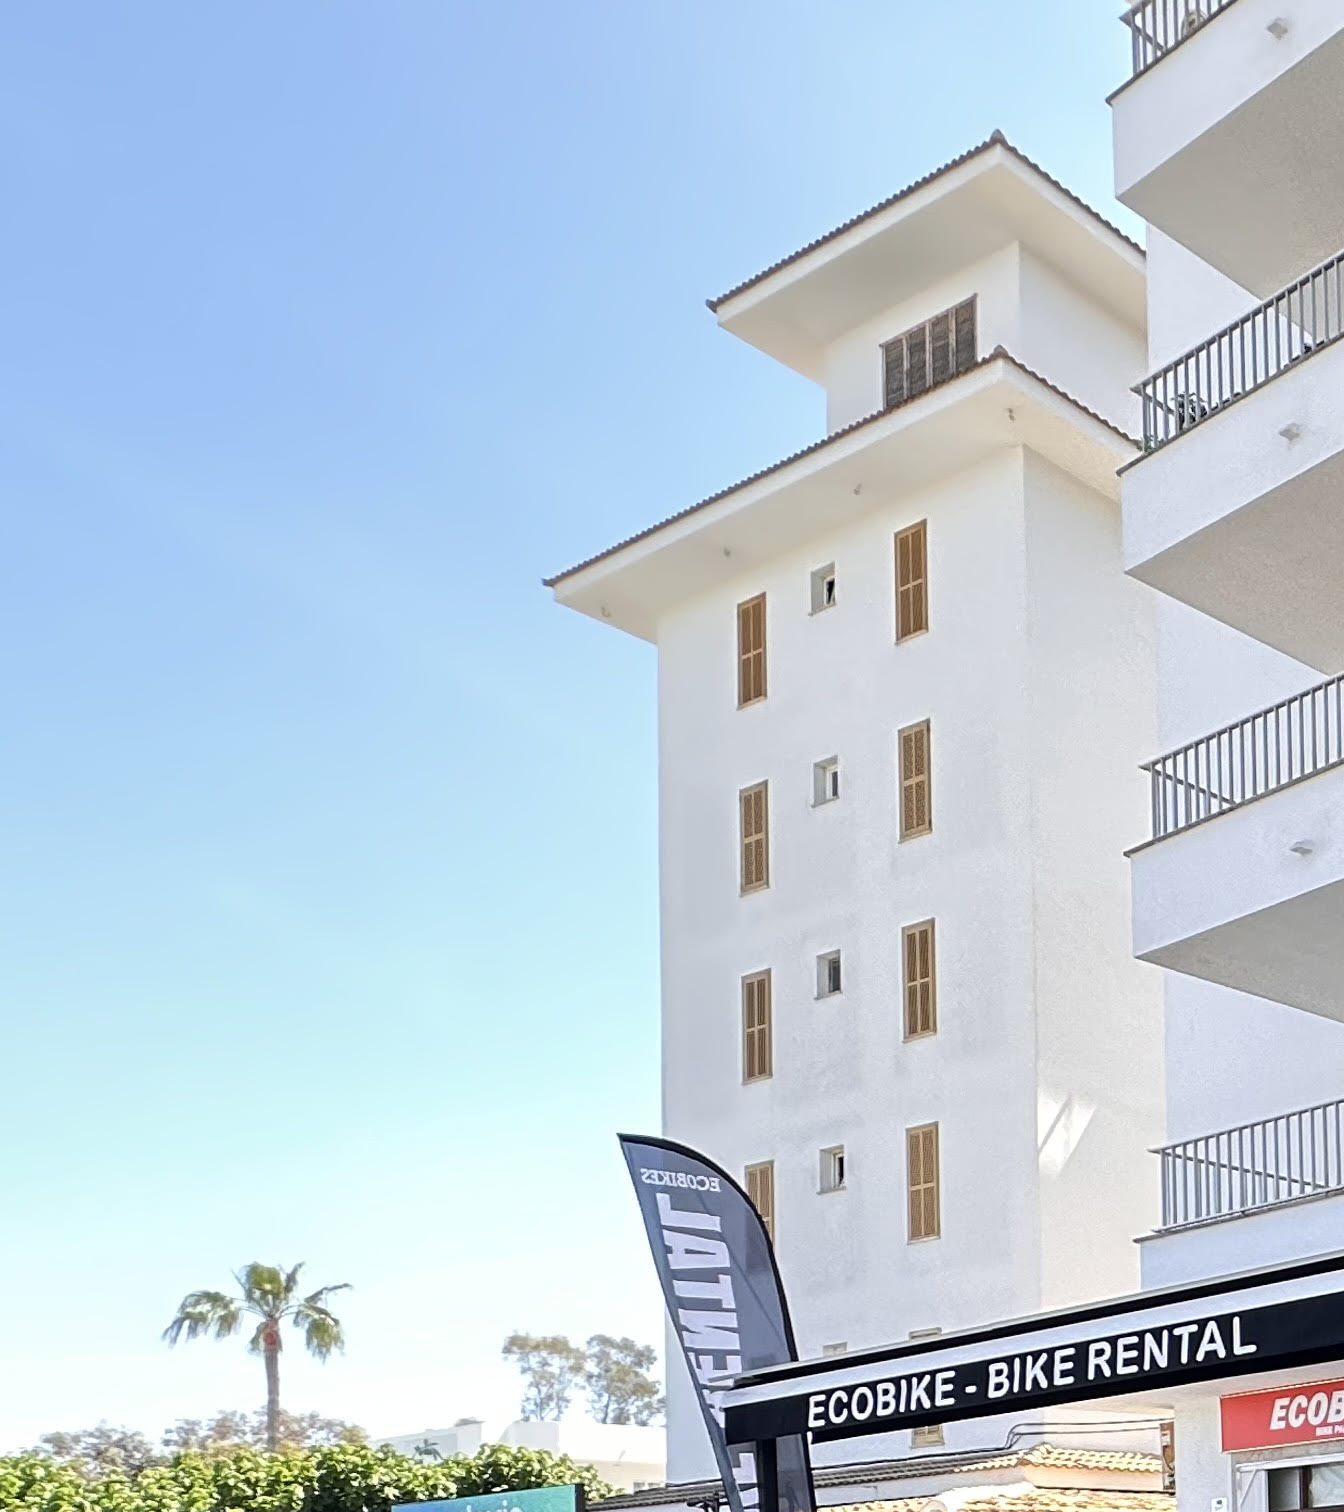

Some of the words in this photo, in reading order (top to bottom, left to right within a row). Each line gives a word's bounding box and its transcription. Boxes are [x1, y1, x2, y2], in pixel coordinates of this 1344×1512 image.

[808, 1371, 958, 1430] ECOBIKE
[986, 1344, 1071, 1401] BIKE
[1087, 1315, 1257, 1382] RENTAL
